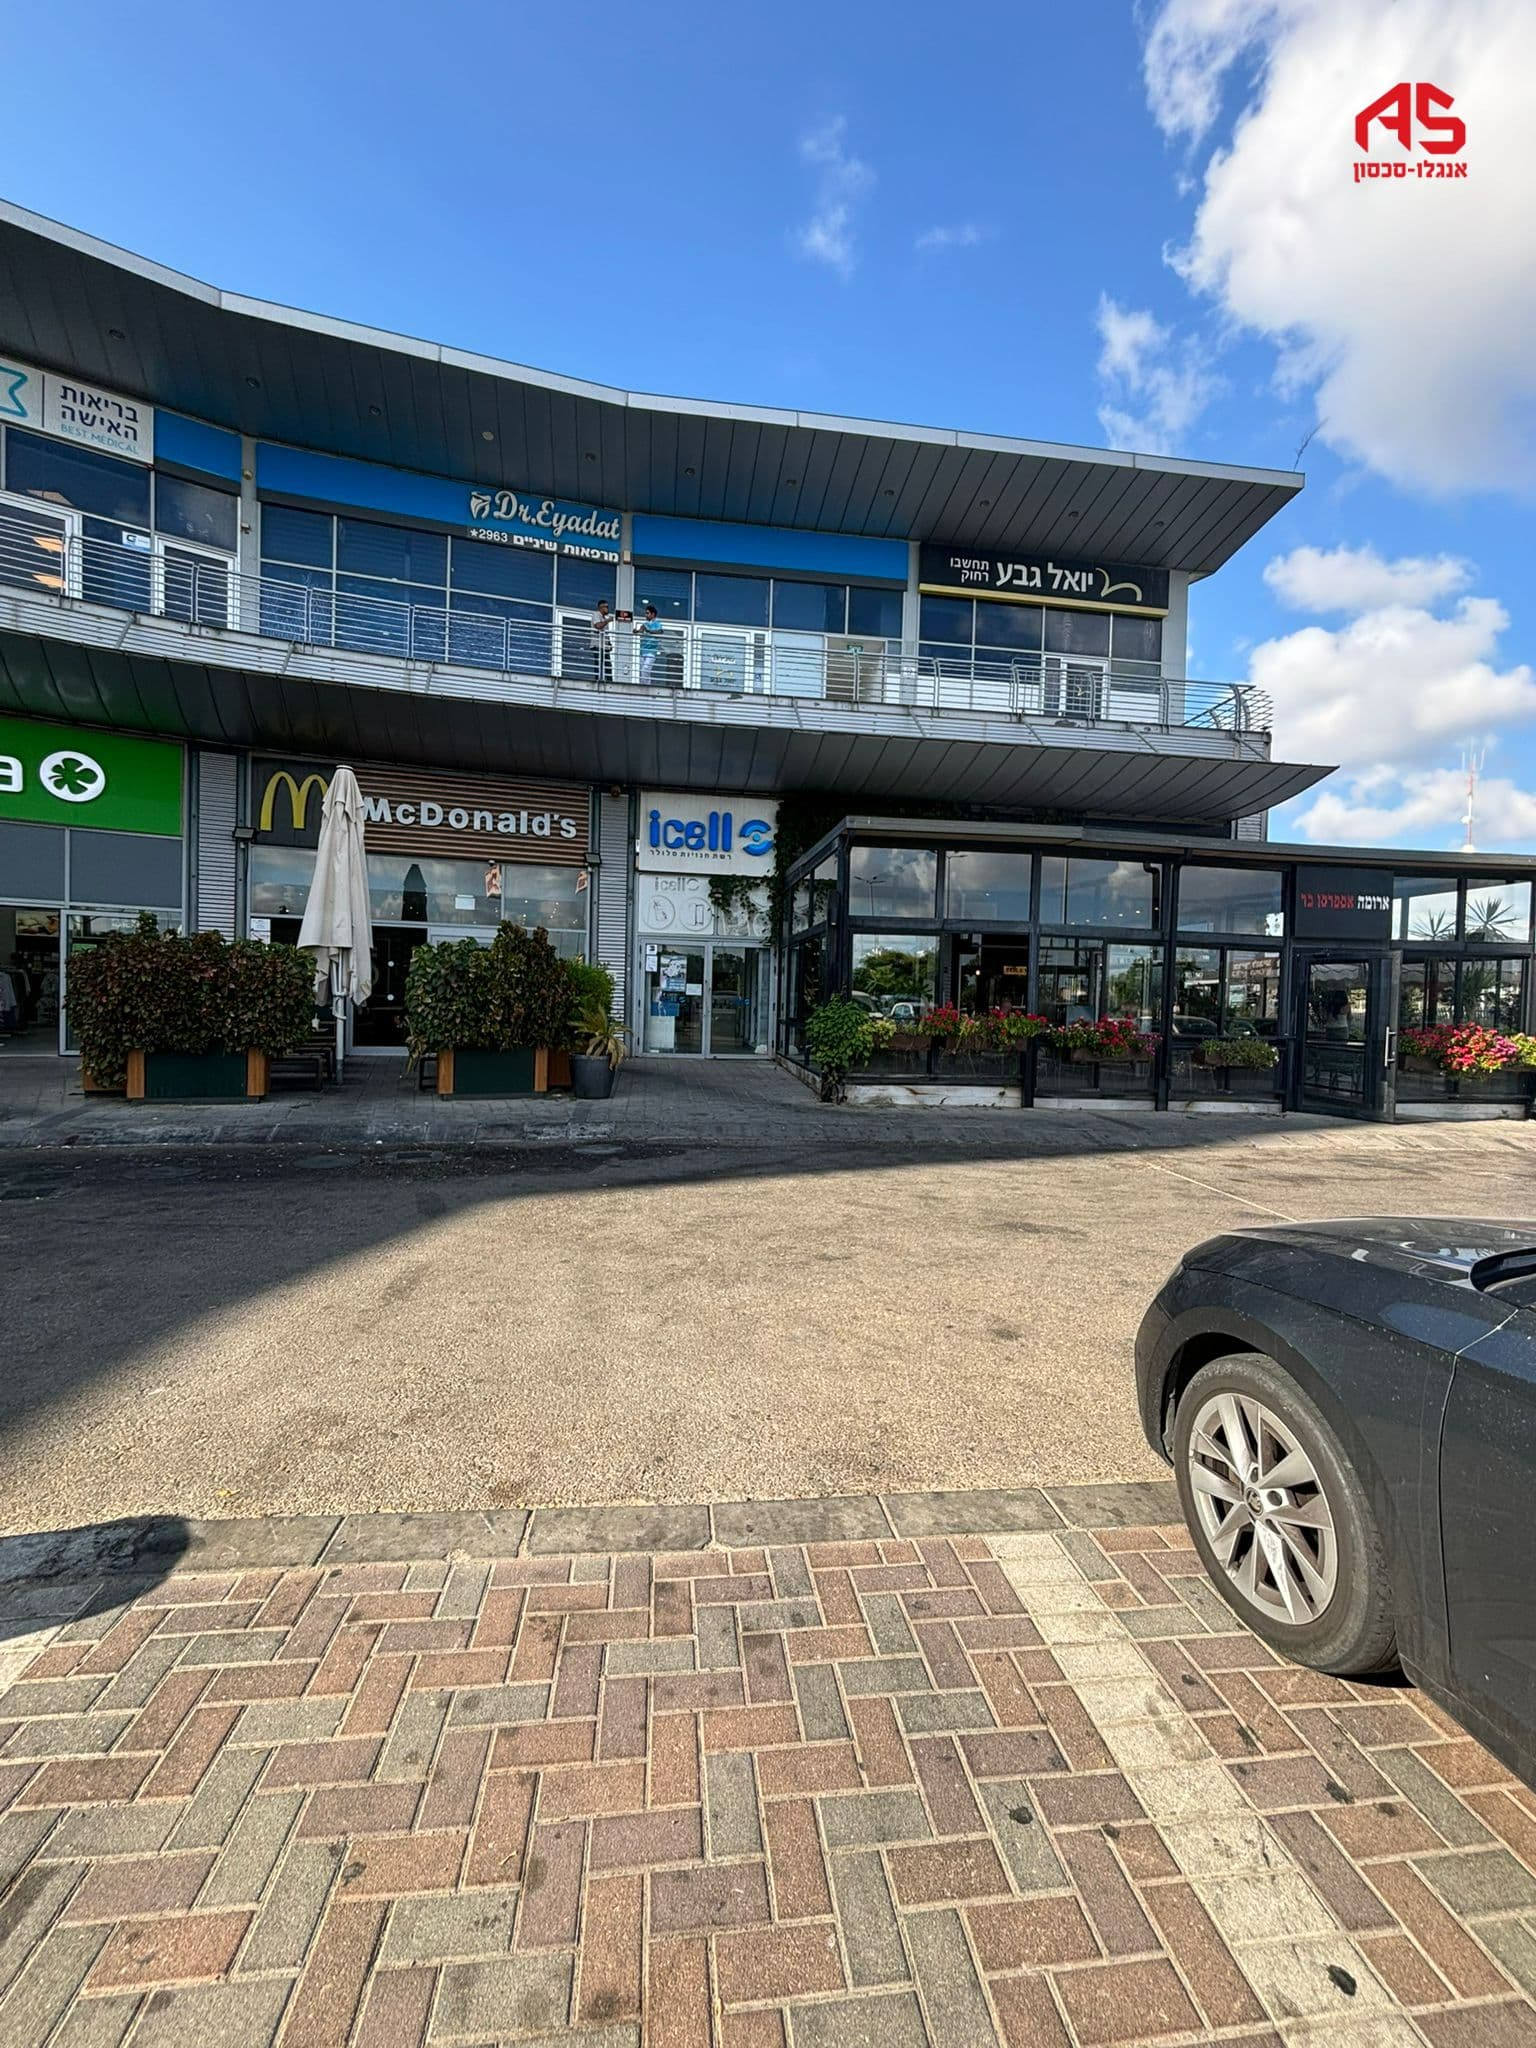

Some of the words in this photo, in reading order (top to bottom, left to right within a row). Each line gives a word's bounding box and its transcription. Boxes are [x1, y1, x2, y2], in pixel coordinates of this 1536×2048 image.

[60, 385, 139, 423] בריאות
[61, 404, 138, 442] האישה
[60, 423, 88, 439] BEST
[91, 433, 140, 455] MEDICAL
[513, 534, 557, 552] שיניים
[563, 543, 619, 563] מרפאות
[950, 557, 990, 571] תחשבו
[961, 569, 989, 583] רחוק
[995, 562, 1042, 588] גבע
[1047, 562, 1094, 592] יואל
[364, 797, 577, 839] McDonald's
[649, 809, 732, 852] icell
[1357, 895, 1390, 910] ארומה
